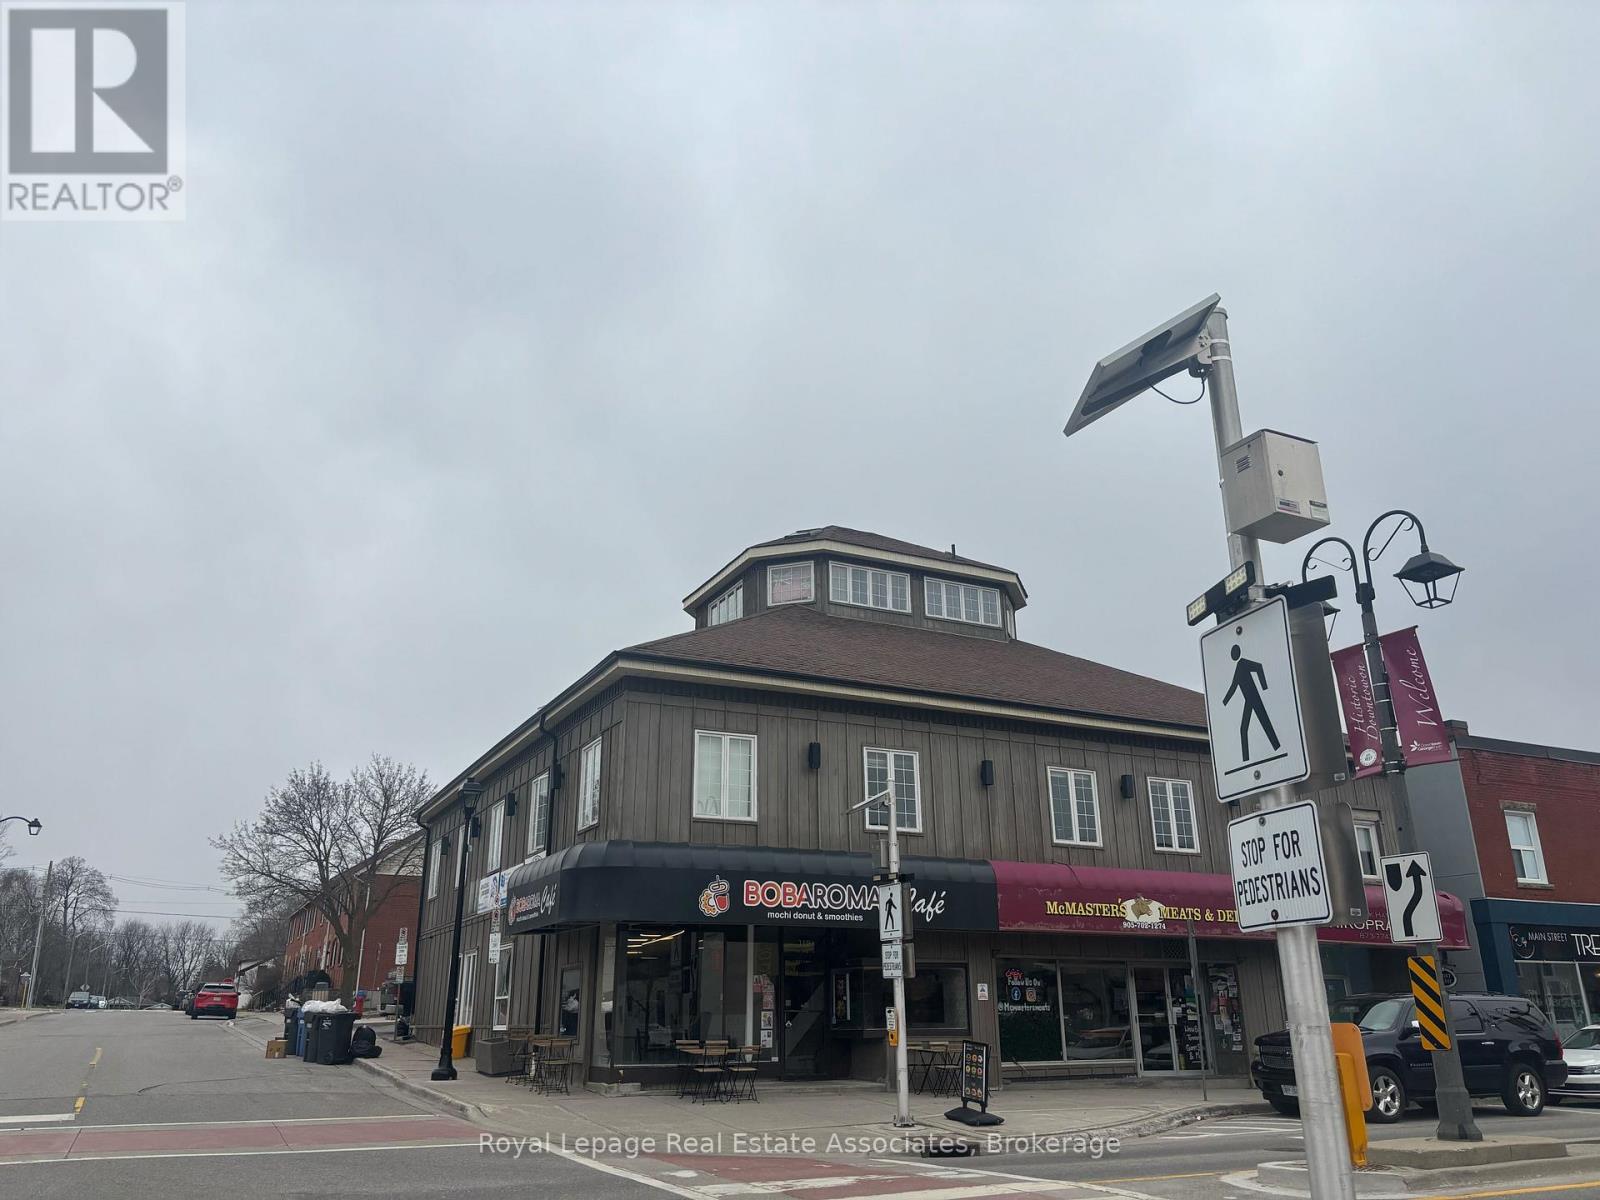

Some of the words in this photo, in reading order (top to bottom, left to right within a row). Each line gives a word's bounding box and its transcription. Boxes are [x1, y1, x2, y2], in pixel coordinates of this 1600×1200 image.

[1398, 647, 1438, 727] Welcome
[1346, 676, 1367, 734] Historic
[1240, 837, 1266, 868] STOP
[1273, 829, 1302, 861] FOR
[743, 879, 880, 911] BOBAROMA
[1236, 866, 1321, 907] PEDESTRIANS
[767, 910, 792, 920] mochi
[792, 910, 816, 921] donut
[817, 912, 823, 921] &
[824, 912, 864, 923] smoothies
[1045, 898, 1128, 918] McMASTER'S
[1159, 906, 1201, 921] MEATS
[1204, 908, 1215, 922] &
[1528, 931, 1546, 941] MAIN
[1547, 932, 1568, 943] STREET
